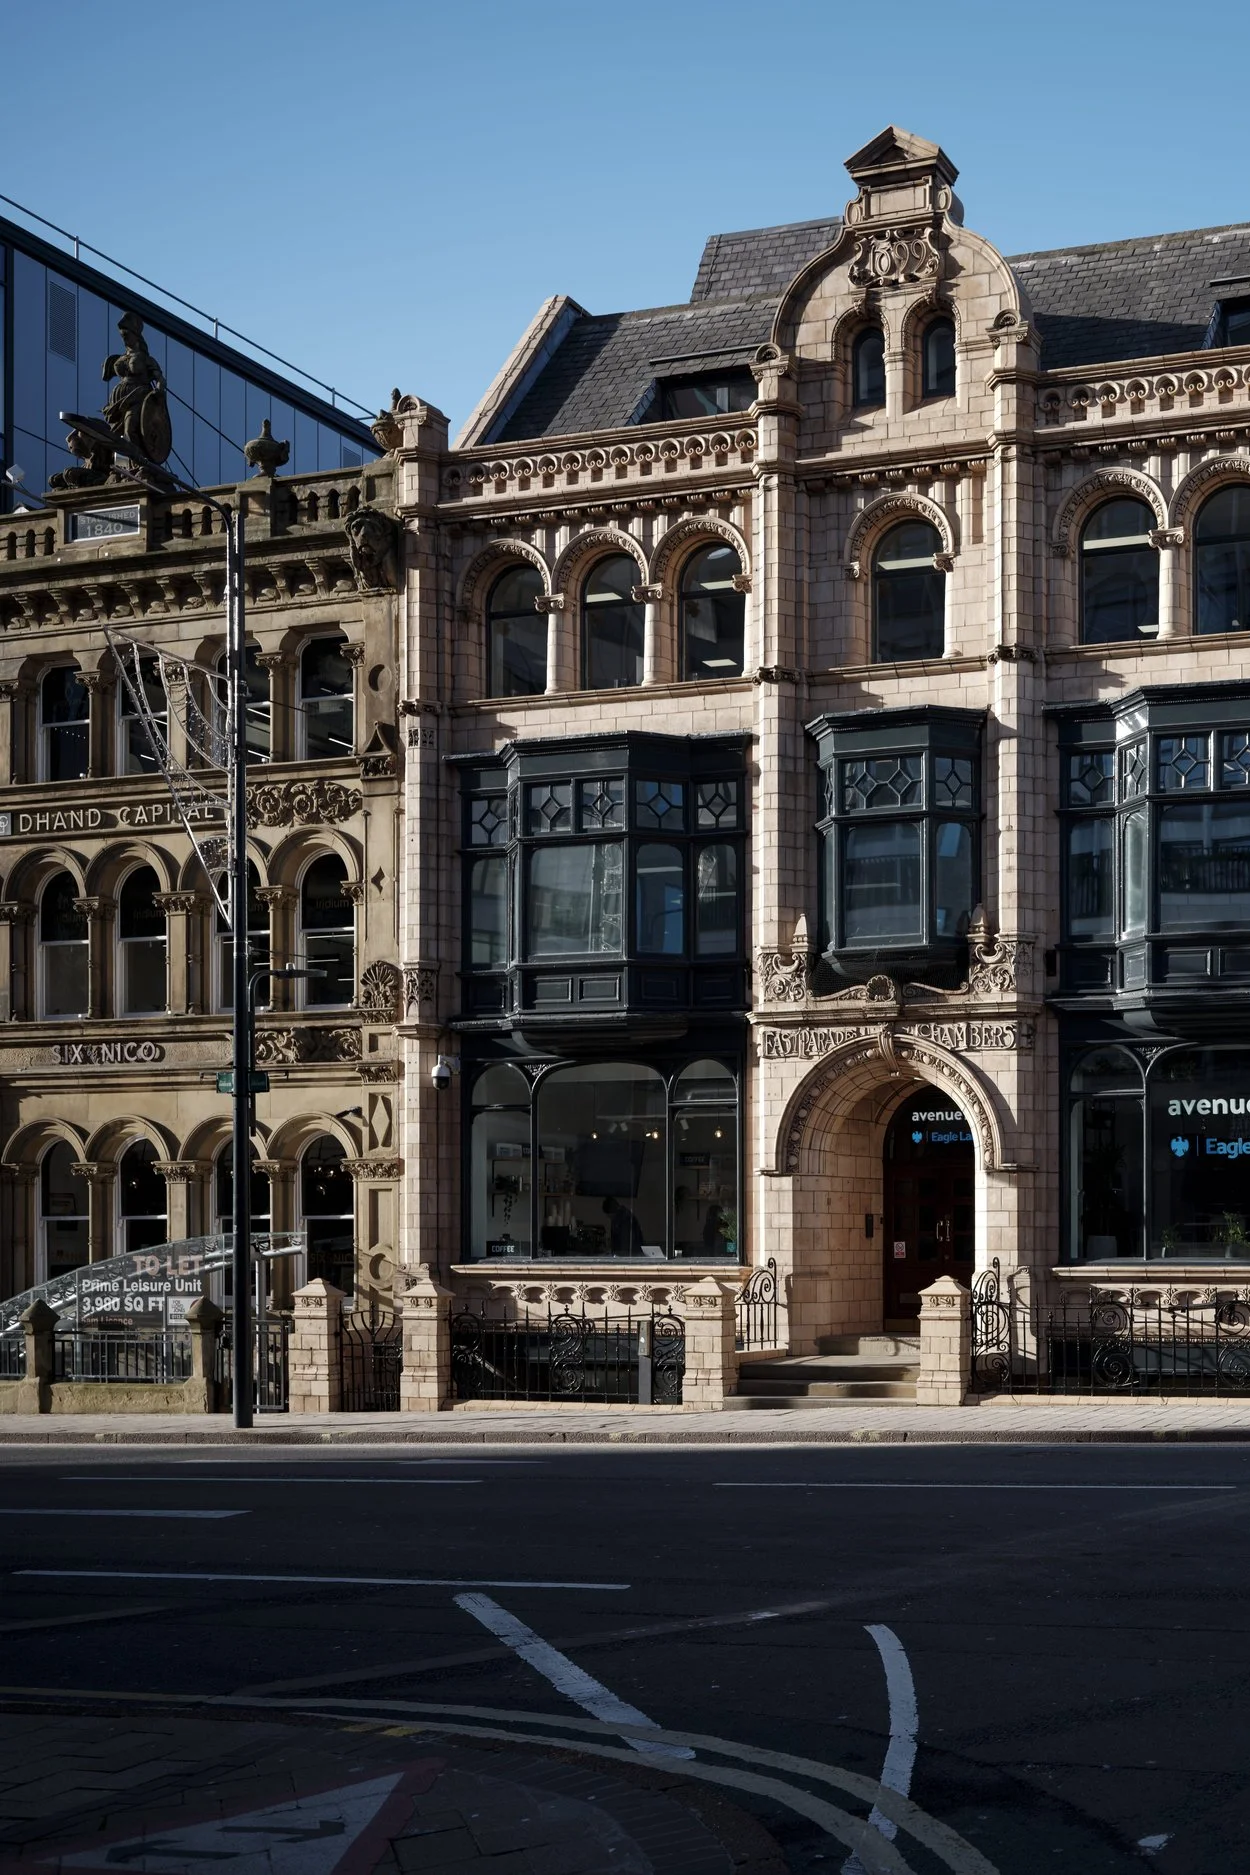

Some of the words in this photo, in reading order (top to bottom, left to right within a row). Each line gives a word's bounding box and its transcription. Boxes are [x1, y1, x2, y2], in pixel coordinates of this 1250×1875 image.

[86, 522, 123, 538] 1840
[20, 808, 102, 833] DHAND
[764, 1030, 799, 1057] EAST
[918, 1023, 1017, 1050] CHAMBERS
[51, 1044, 83, 1064] SIX
[102, 1041, 156, 1062] NICO
[931, 1131, 959, 1144] Eagle
[491, 1244, 515, 1253] COFFEE
[132, 1255, 161, 1276] TO
[166, 1254, 204, 1276] LET
[82, 1279, 120, 1292] Prime
[123, 1279, 171, 1292] Leisure
[175, 1279, 202, 1292] Unit
[82, 1296, 120, 1313] 3,980
[124, 1296, 144, 1312] SQ
[148, 1296, 165, 1311] FT
